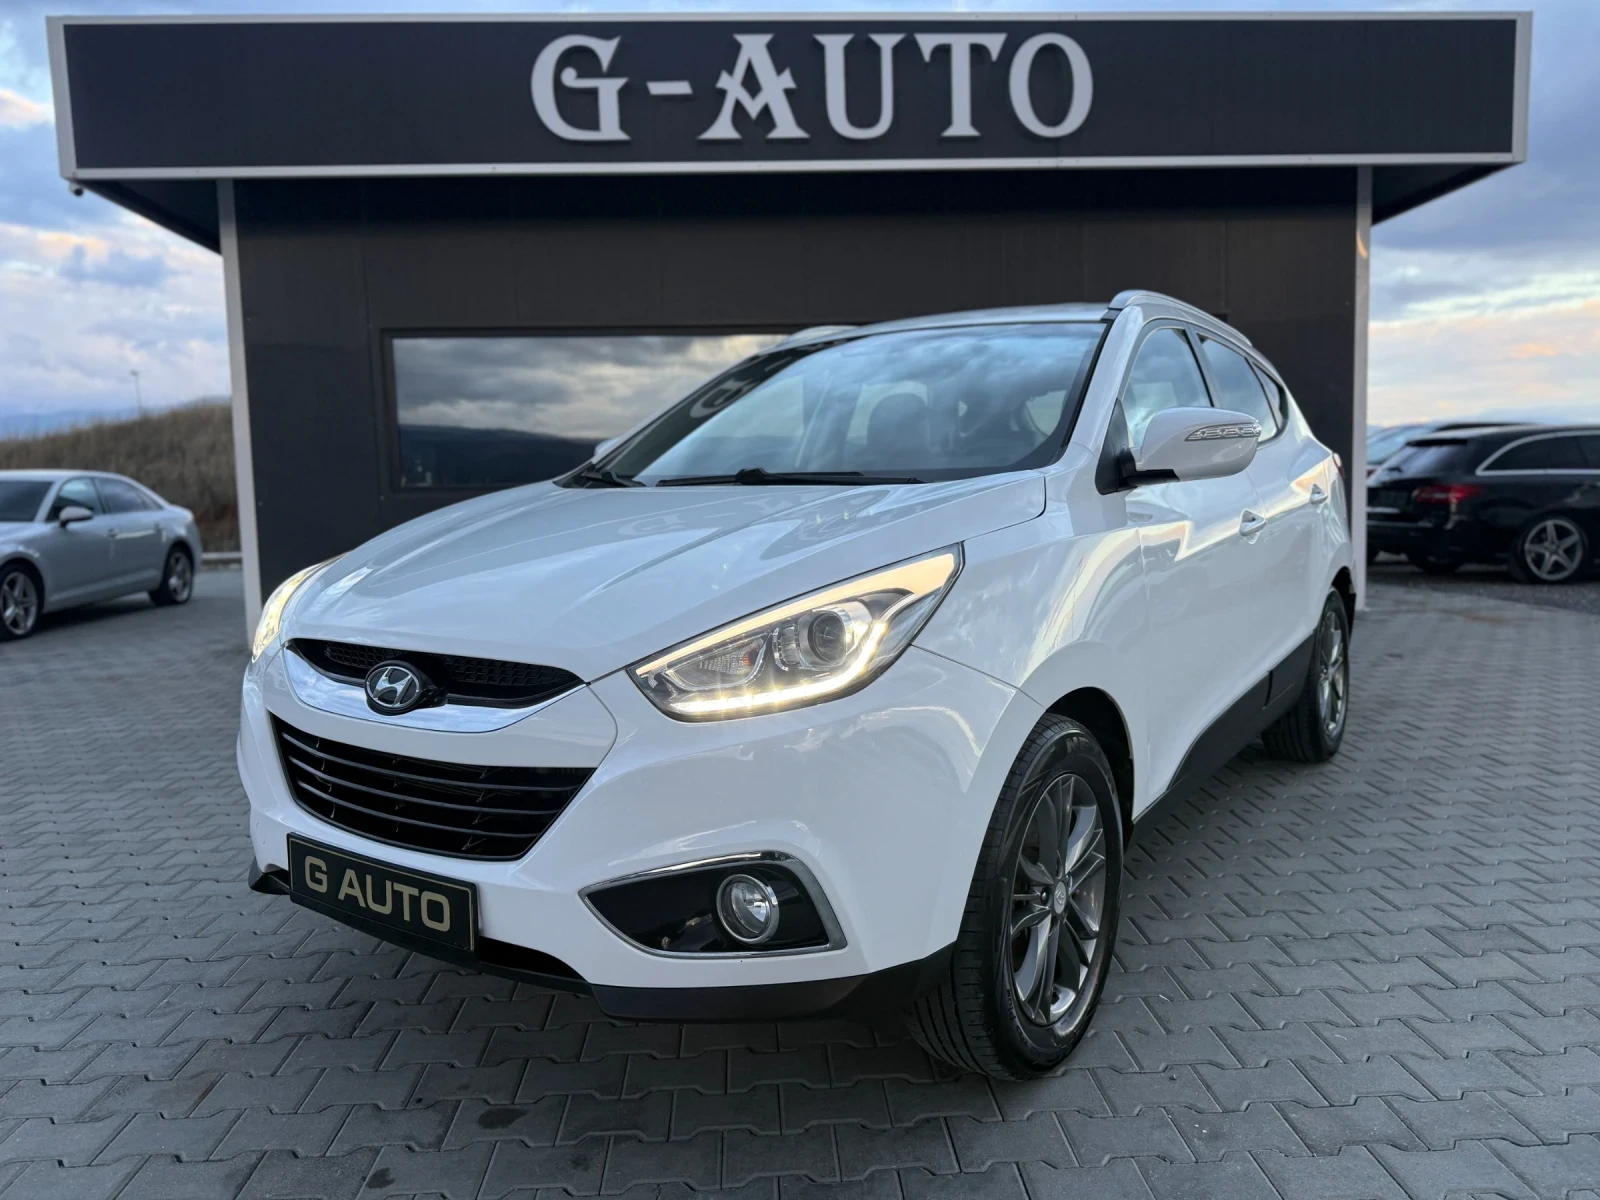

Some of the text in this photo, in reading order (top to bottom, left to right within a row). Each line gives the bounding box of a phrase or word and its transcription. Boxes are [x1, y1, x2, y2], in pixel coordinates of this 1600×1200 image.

[531, 33, 1093, 141] G-AUTO
[305, 856, 450, 932] G AUTO
